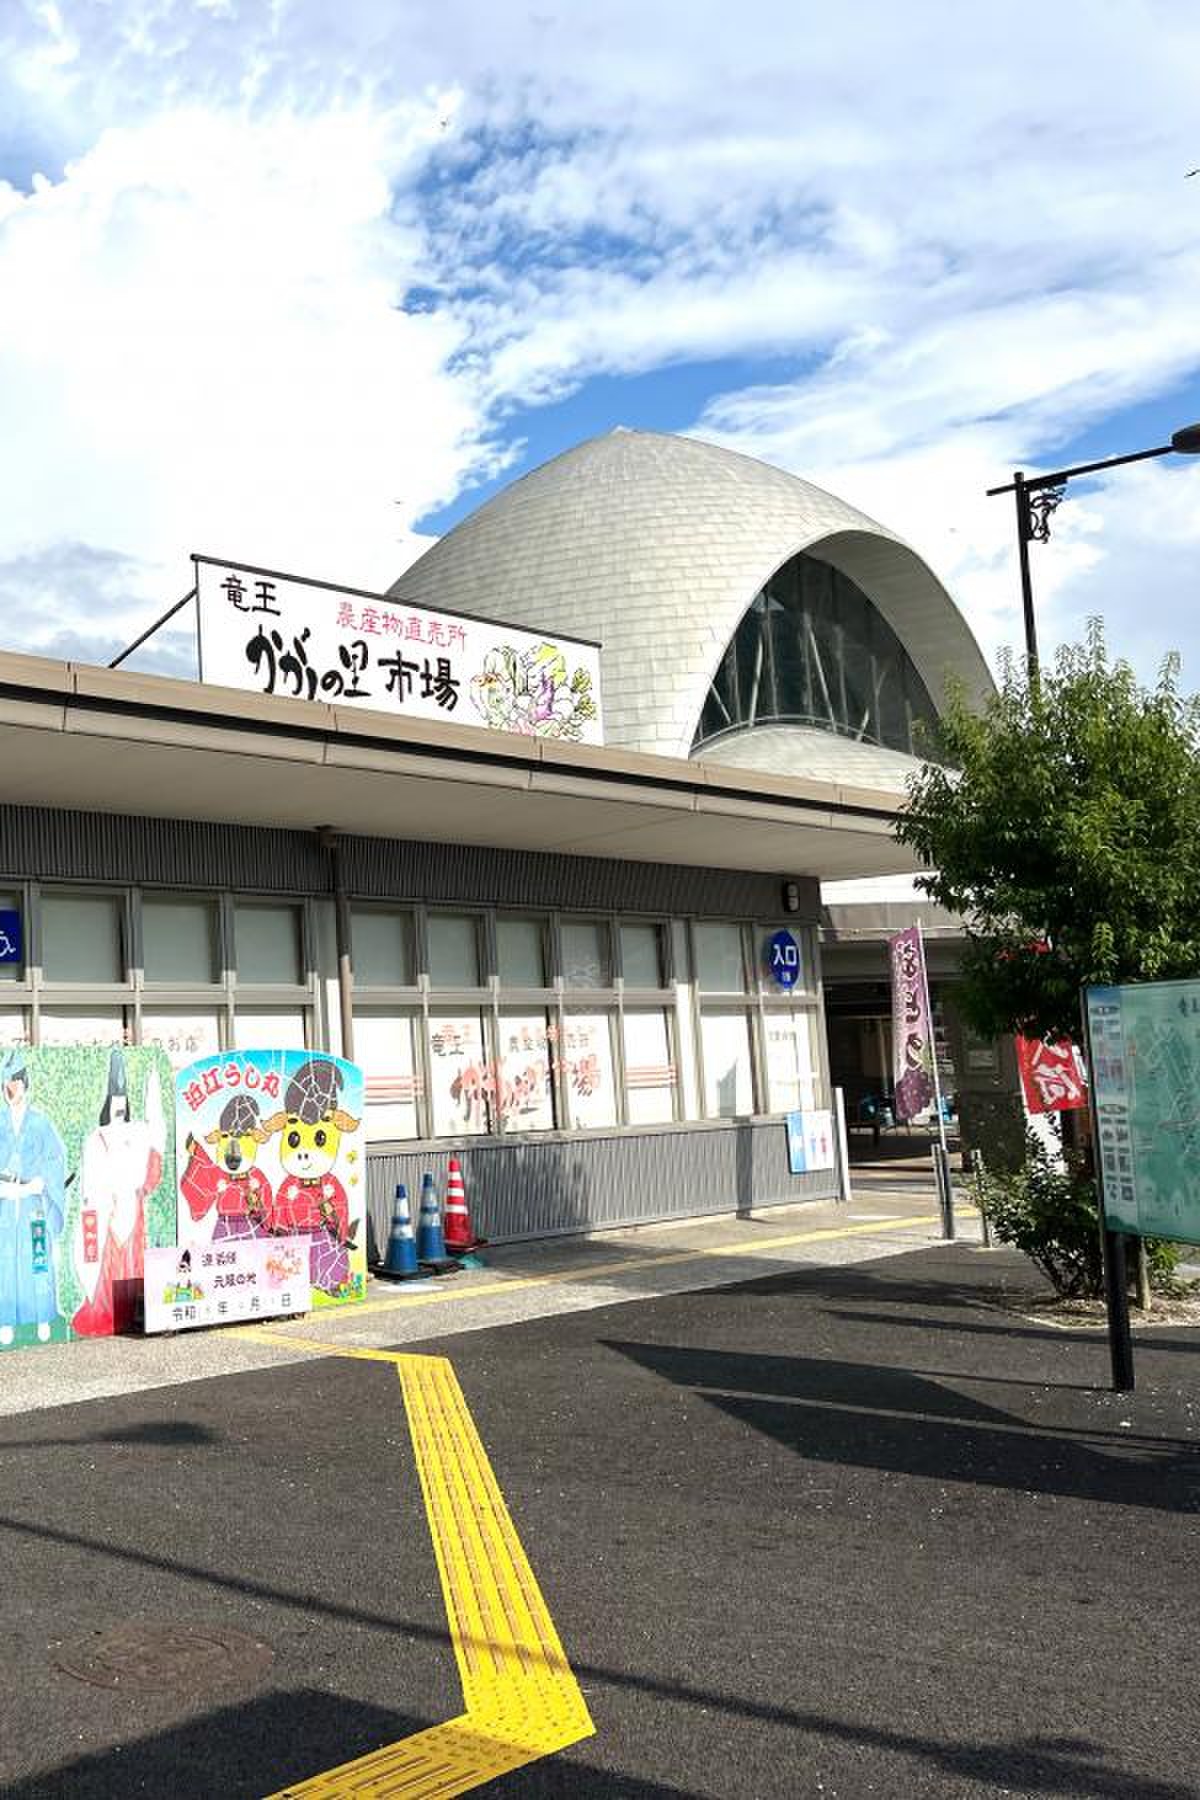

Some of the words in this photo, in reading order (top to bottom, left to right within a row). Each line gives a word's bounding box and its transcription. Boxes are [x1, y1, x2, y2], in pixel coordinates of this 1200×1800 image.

[220, 574, 281, 616] 竜王
[336, 601, 467, 650] 農産物直売所
[773, 944, 798, 966] 入口
[183, 1062, 281, 1112] 近江うし丸
